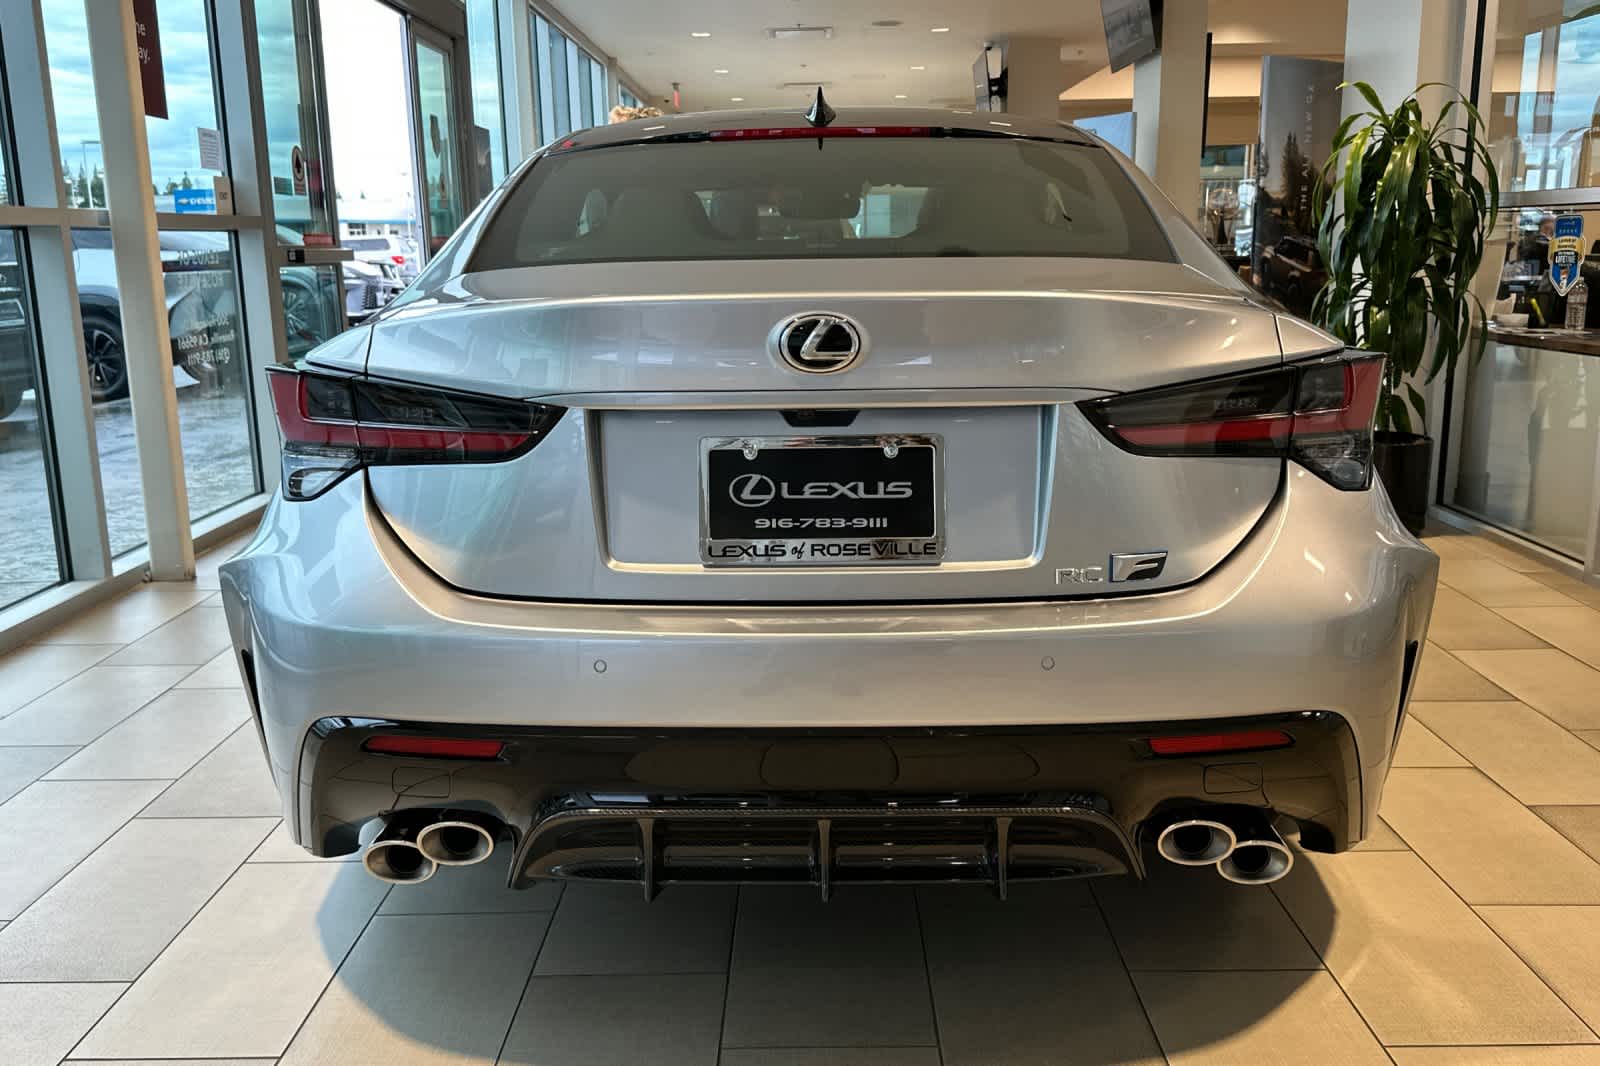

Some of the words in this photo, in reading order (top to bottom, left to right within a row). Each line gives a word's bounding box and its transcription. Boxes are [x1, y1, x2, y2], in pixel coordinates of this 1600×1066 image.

[1300, 184, 1309, 211] THE
[781, 481, 913, 499] LEXUS
[754, 517, 888, 529] 916-783-9111
[708, 543, 787, 558] LEXUS
[791, 541, 806, 560] of
[811, 543, 937, 556] ROSEVILLE
[1055, 567, 1103, 585] RC
